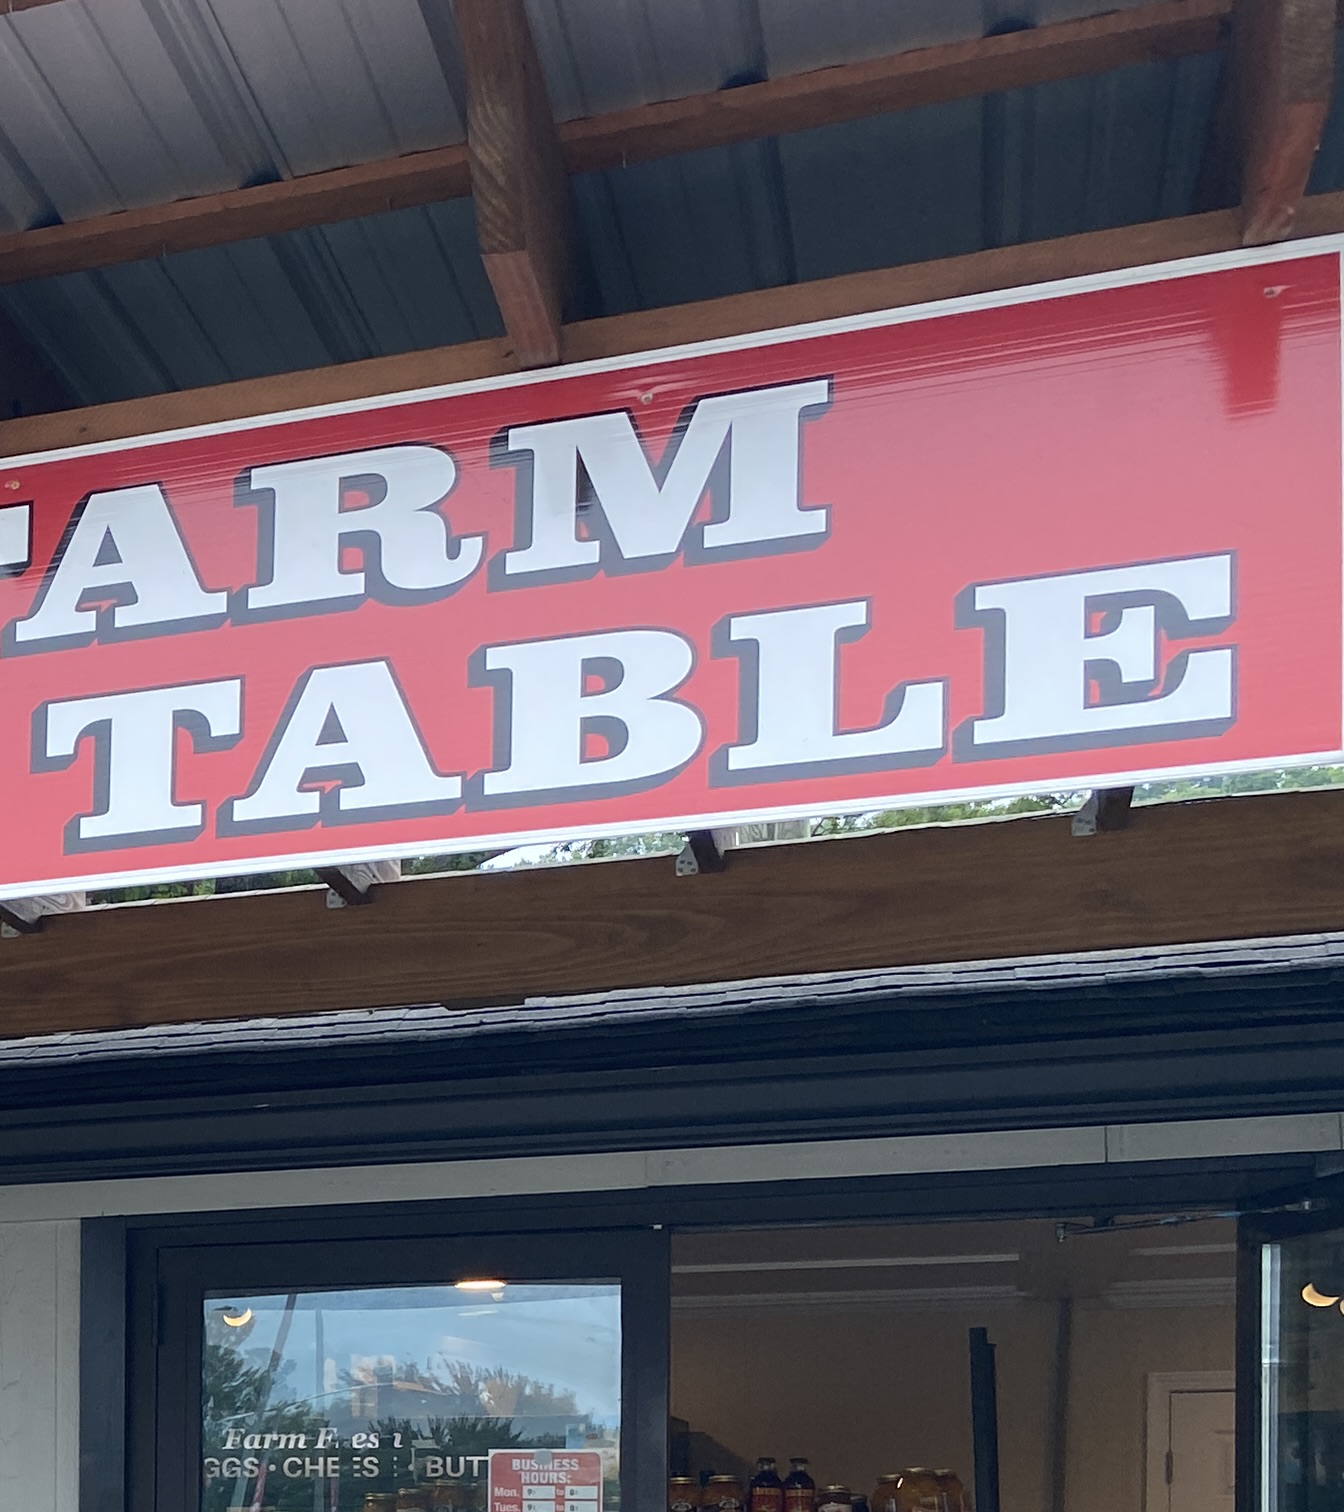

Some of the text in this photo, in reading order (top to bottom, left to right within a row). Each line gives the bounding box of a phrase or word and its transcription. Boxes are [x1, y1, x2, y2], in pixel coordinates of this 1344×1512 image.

[31, 549, 1238, 855] TABLE
[222, 1428, 306, 1450] Farm
[204, 1456, 260, 1478] GGS
[521, 1472, 572, 1484] HOURS:
[494, 1487, 520, 1497] Mon.
[494, 1502, 520, 1512] Tues.
